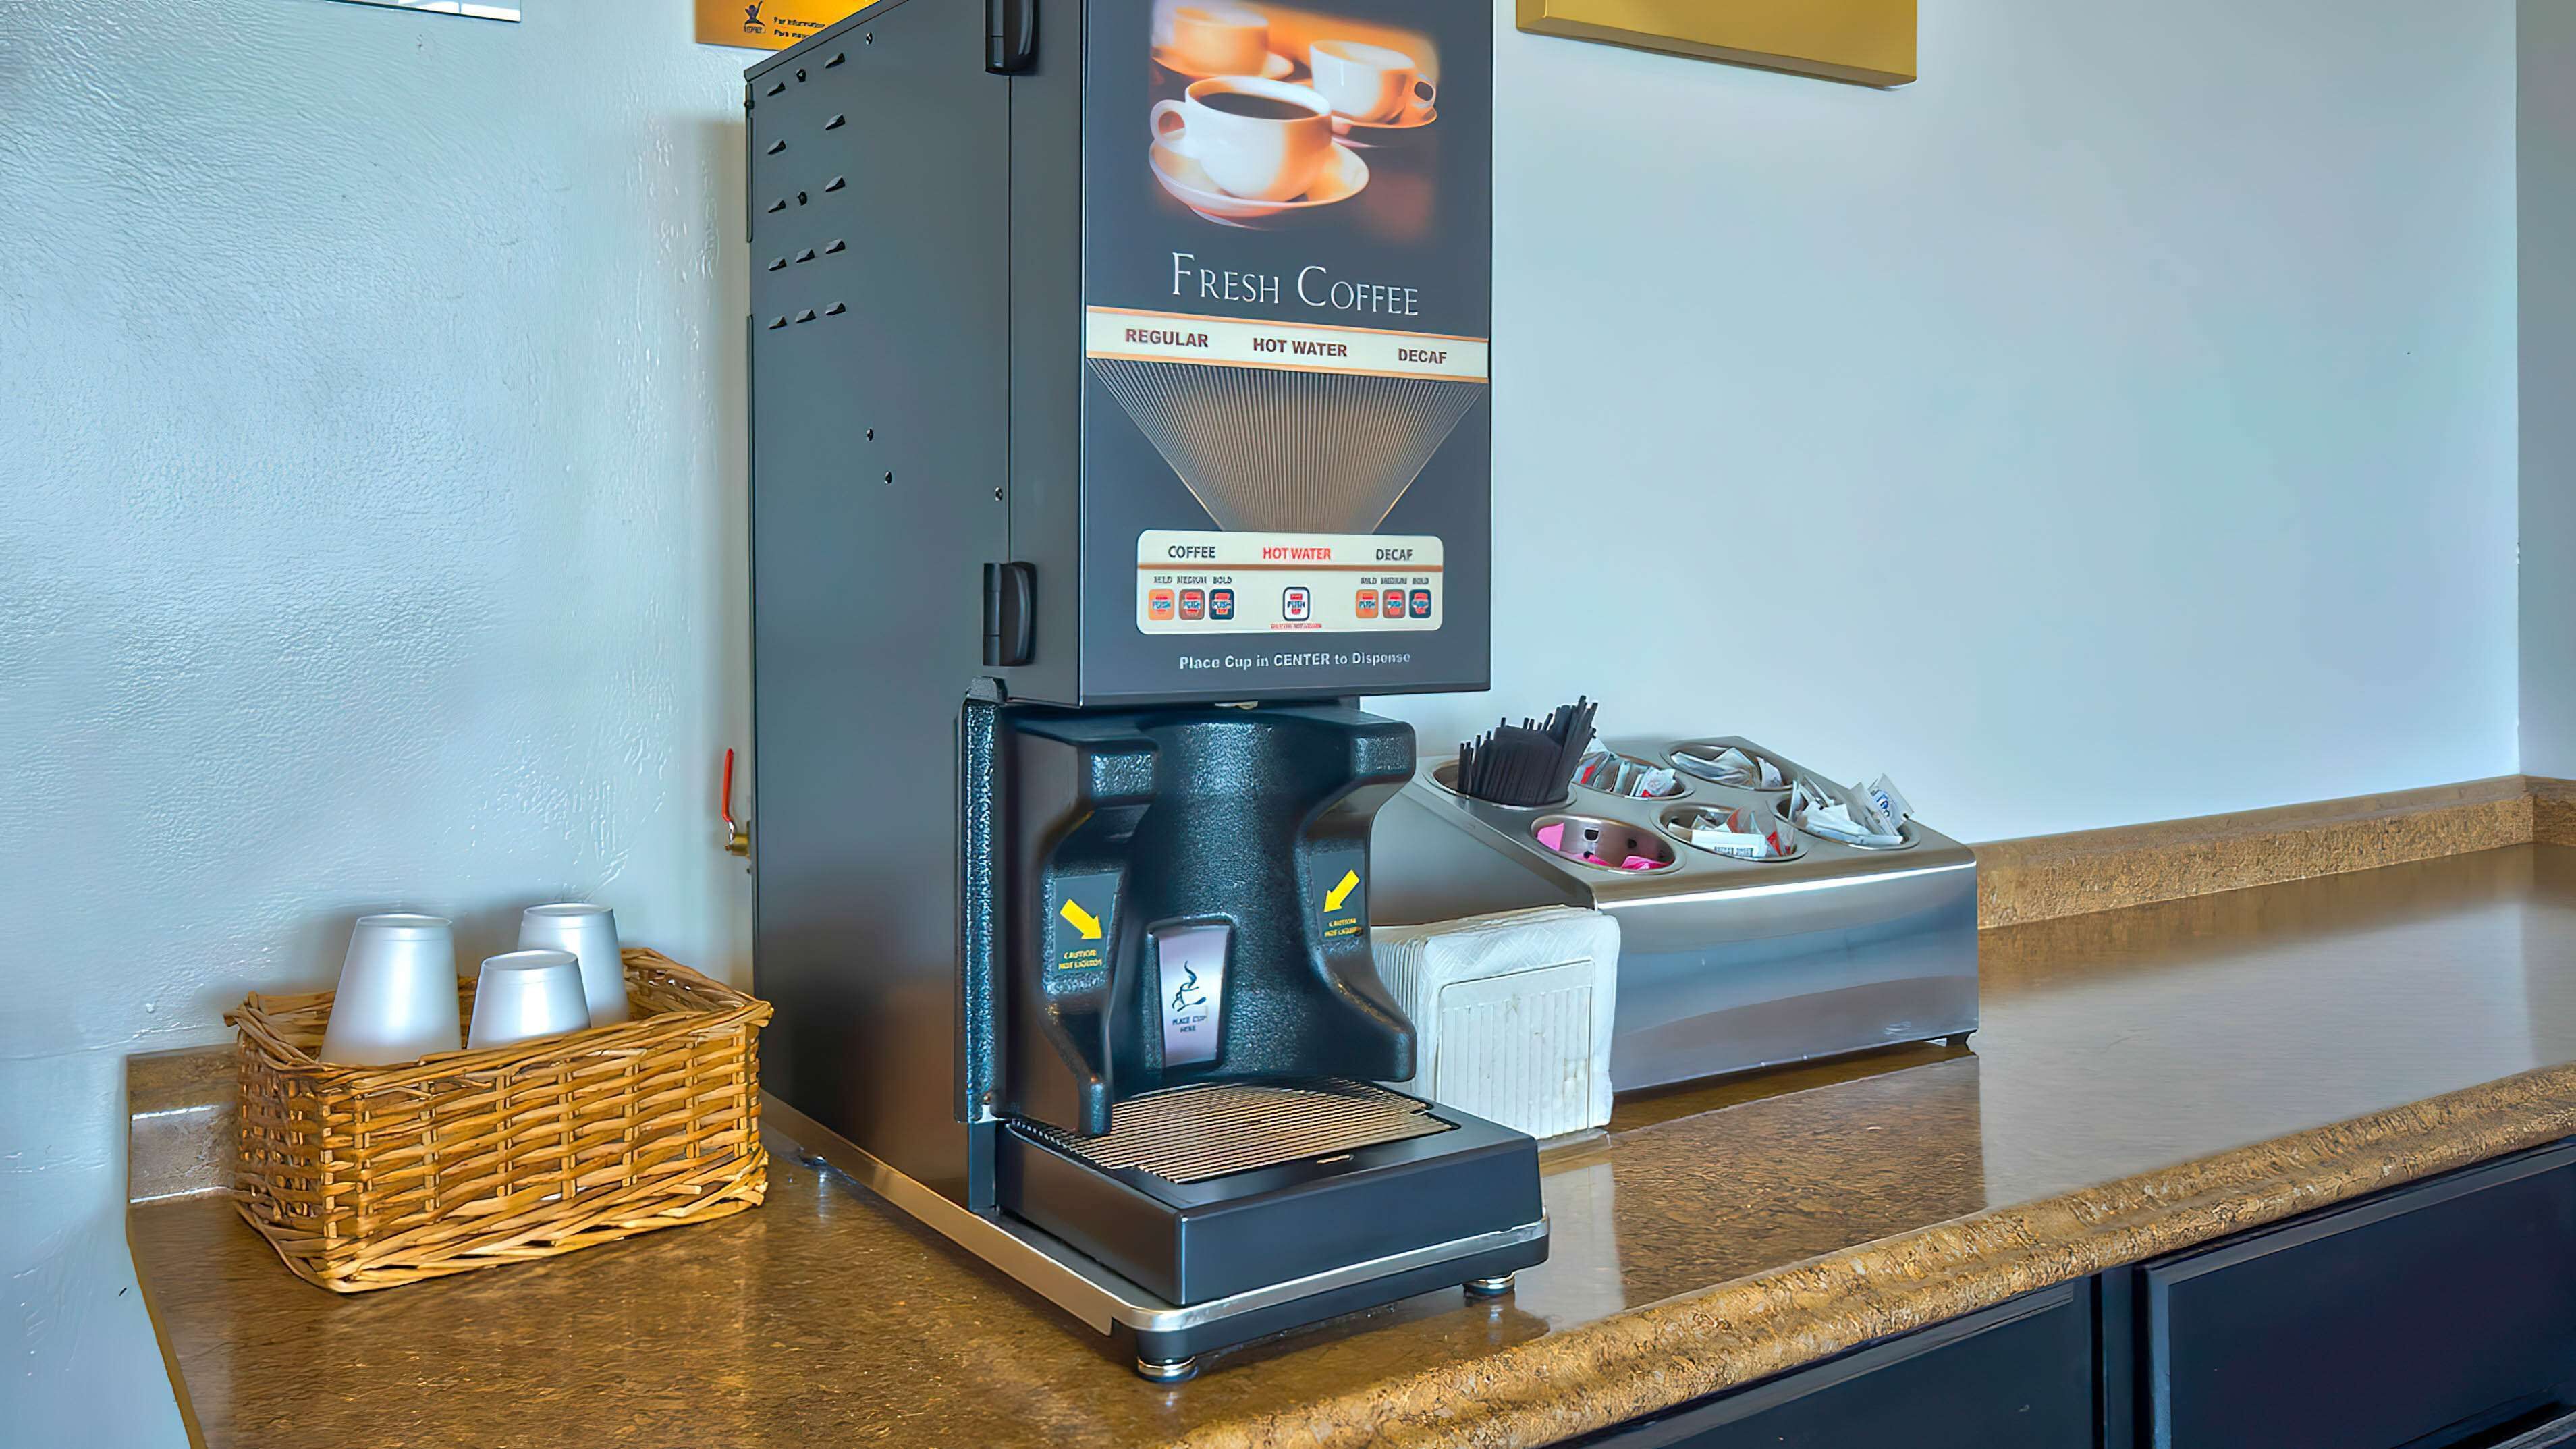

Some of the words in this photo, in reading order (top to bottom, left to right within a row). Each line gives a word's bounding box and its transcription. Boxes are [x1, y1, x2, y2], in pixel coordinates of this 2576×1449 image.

[1125, 328, 1209, 348] REGULAR
[1253, 337, 1286, 353] HOT
[1292, 340, 1348, 358] WATER
[1398, 348, 1448, 365] DECAF
[1168, 545, 1216, 559] COFFEE
[1263, 547, 1288, 560] HOT
[1291, 547, 1332, 561] WATER
[1375, 549, 1413, 561] DECAF
[1180, 656, 1220, 669] Place
[1224, 655, 1252, 670] Cup
[1256, 655, 1269, 667] in
[1273, 653, 1330, 667] CENTER
[1334, 653, 1348, 665] to
[1352, 651, 1410, 666] Dispense
